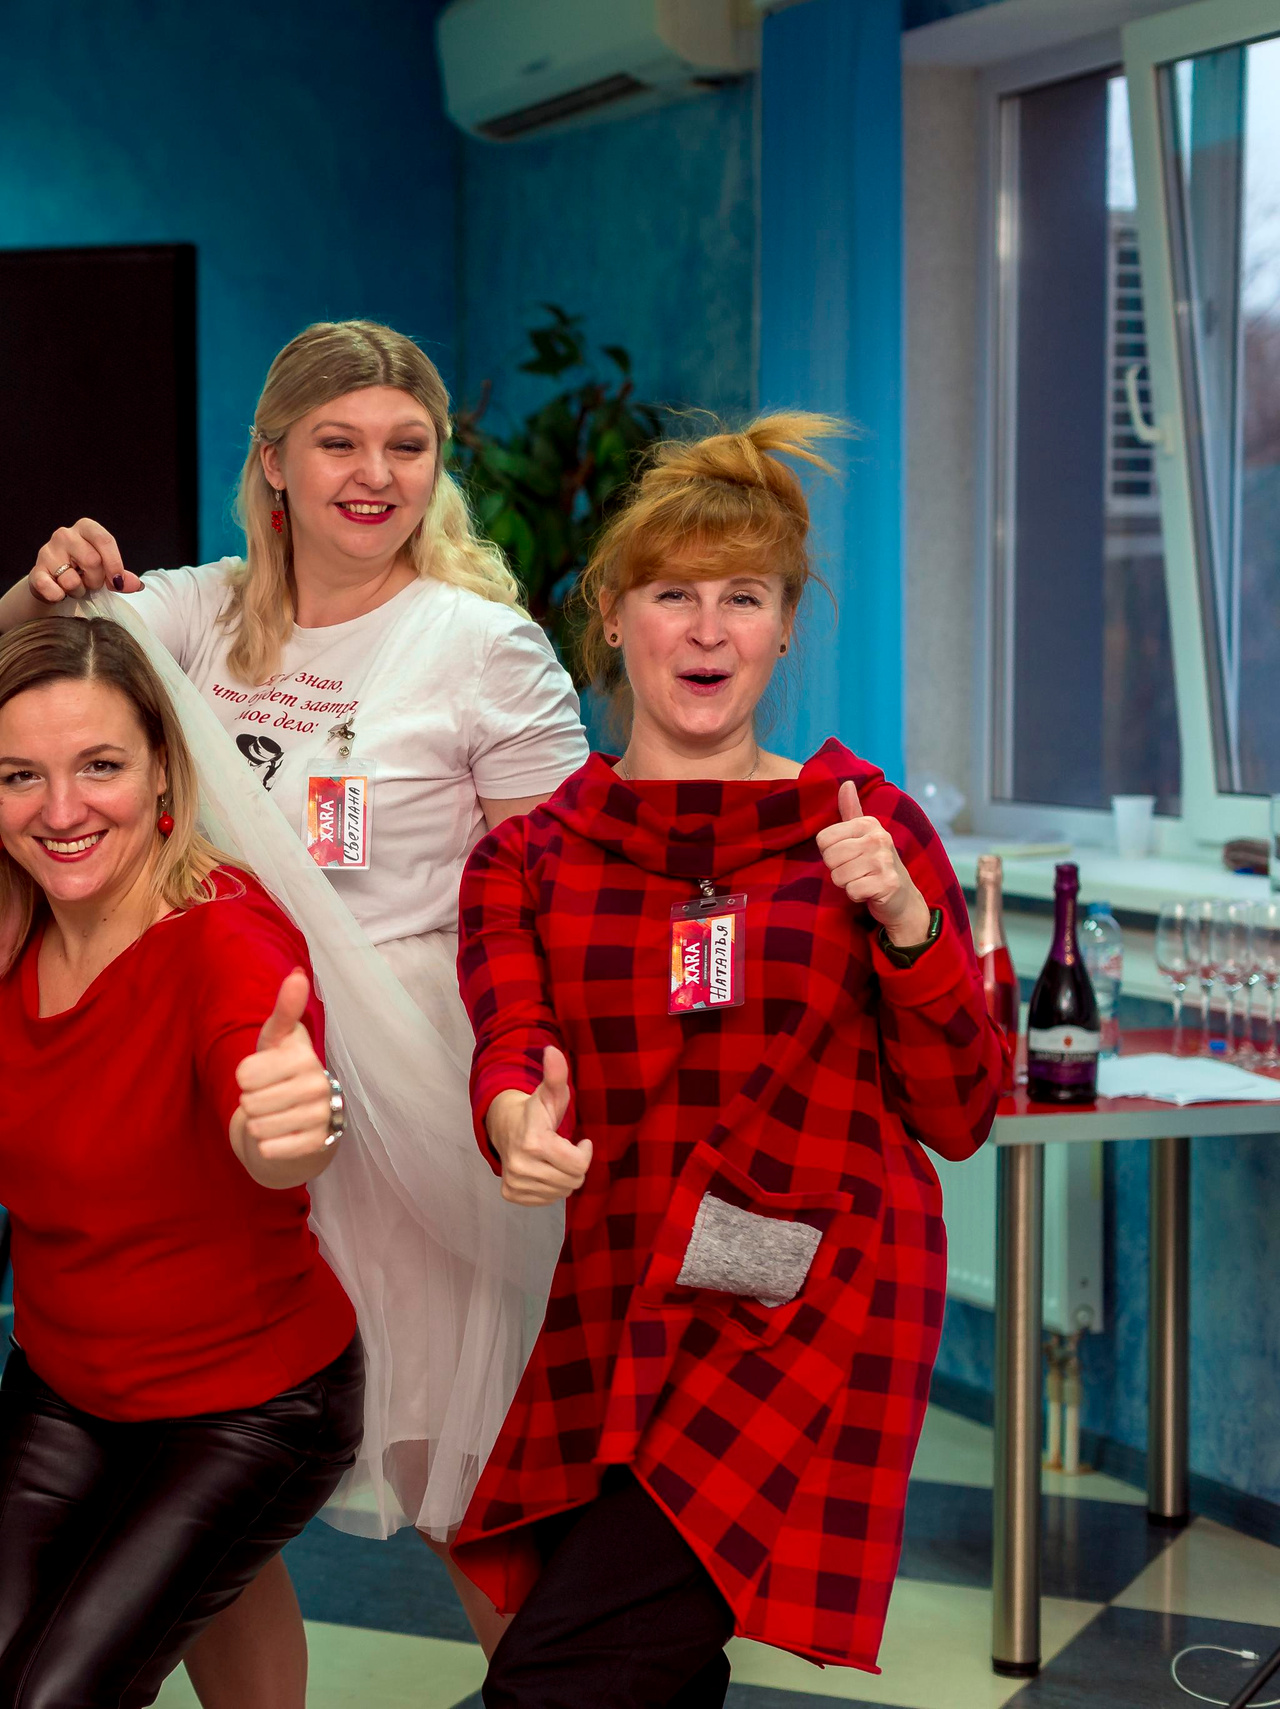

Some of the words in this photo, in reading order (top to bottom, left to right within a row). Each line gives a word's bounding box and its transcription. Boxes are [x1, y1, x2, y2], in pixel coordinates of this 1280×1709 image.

[295, 672, 343, 693] знаю,
[212, 684, 248, 703] что
[273, 711, 319, 733] дело:
